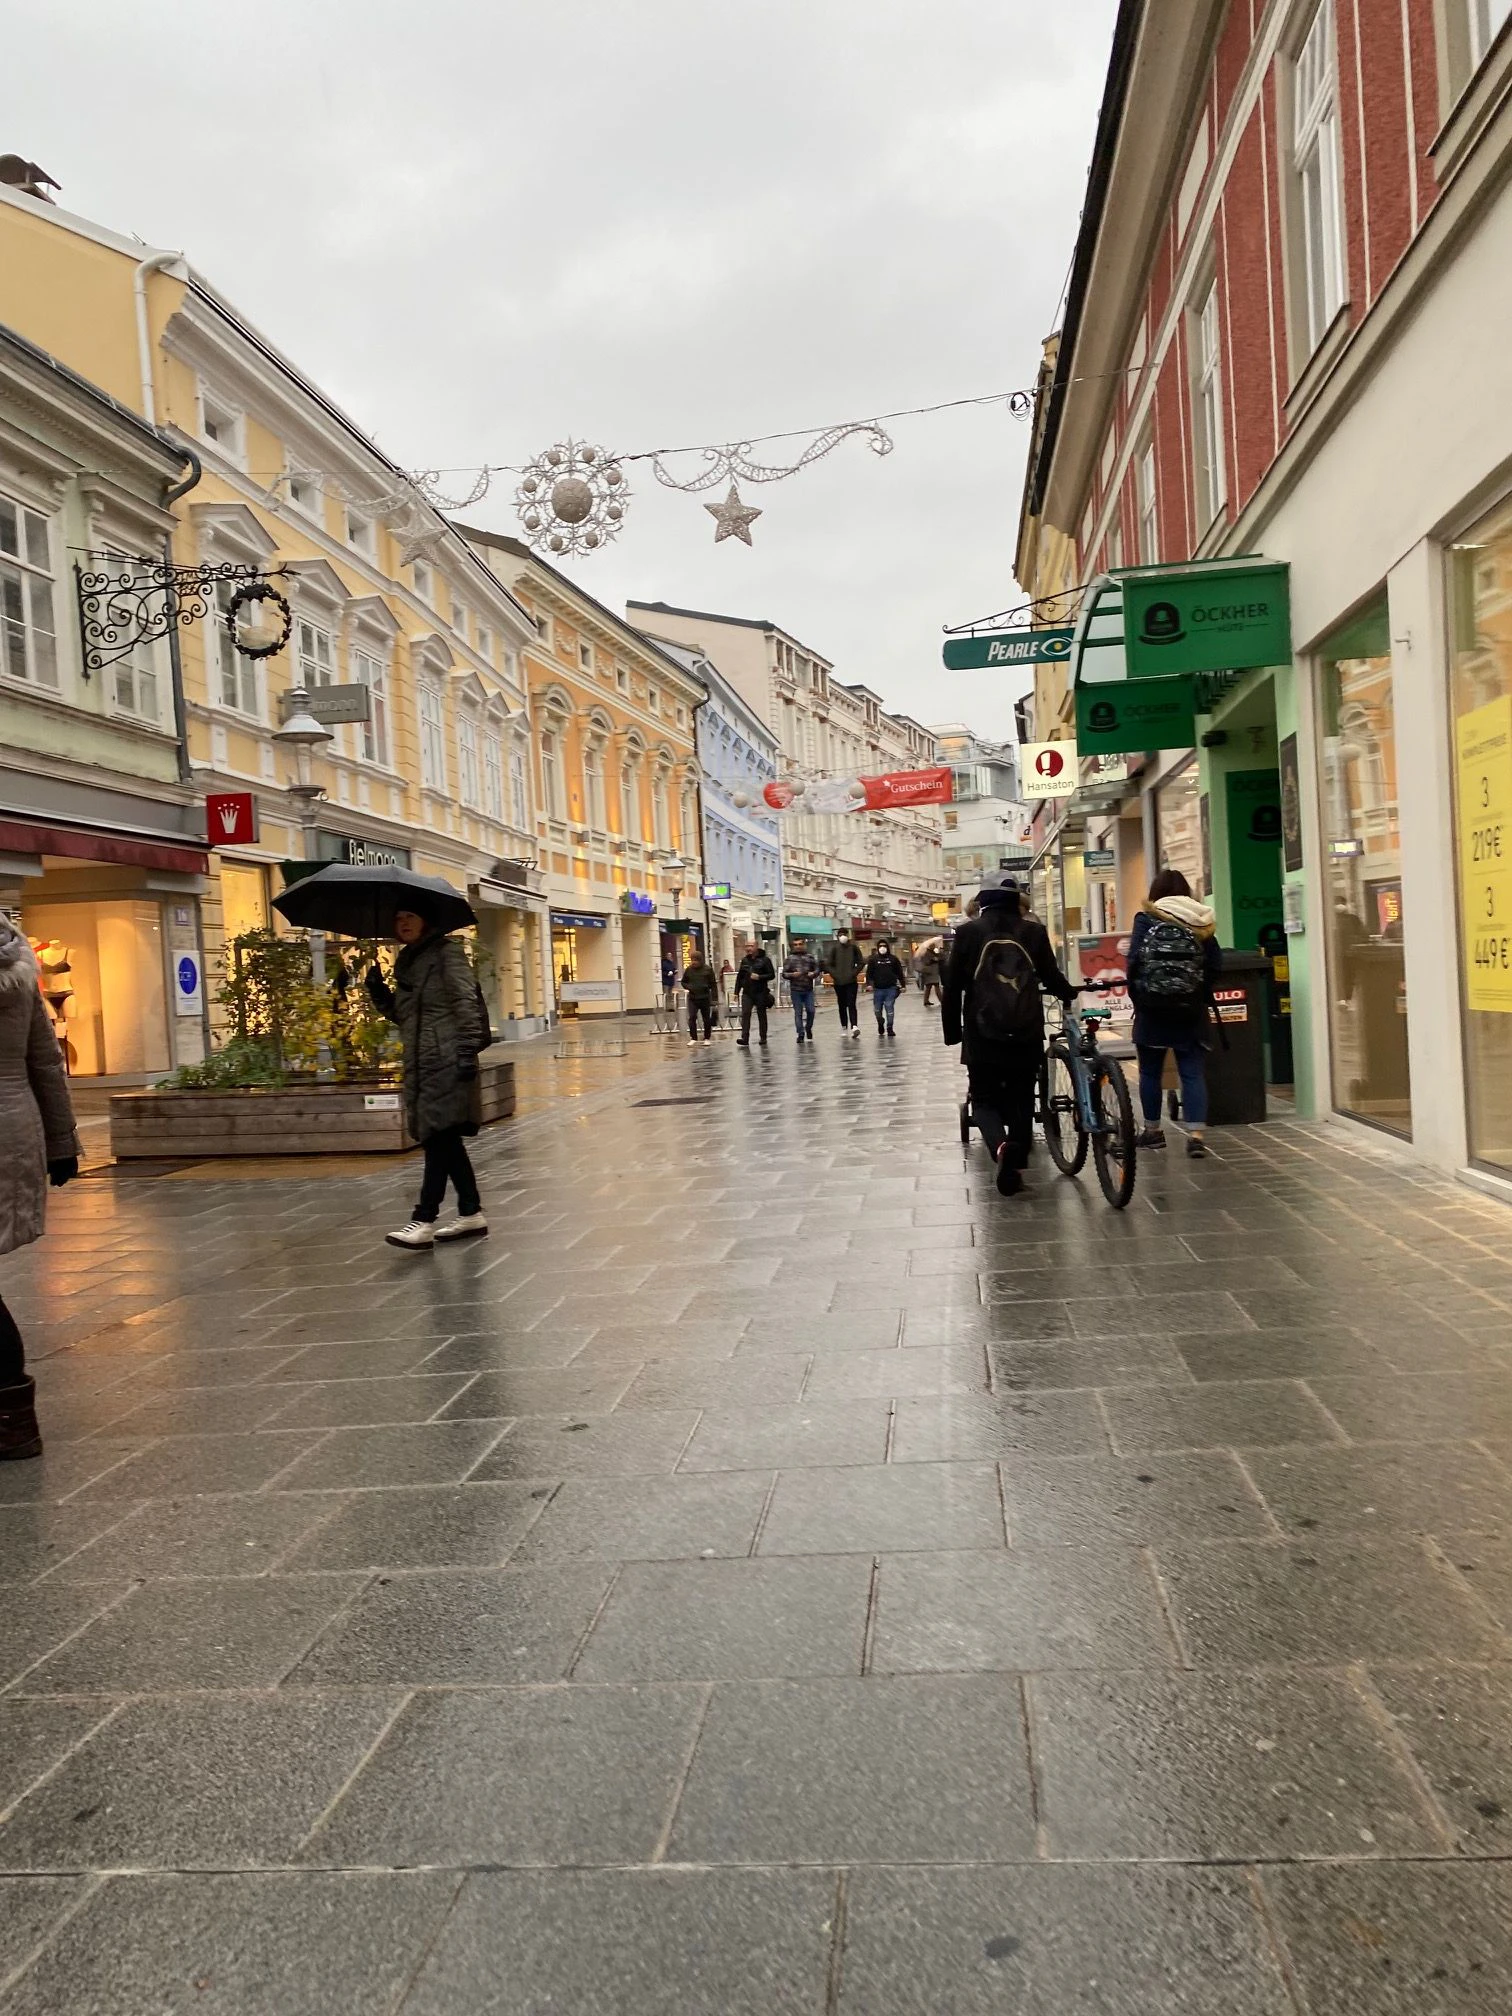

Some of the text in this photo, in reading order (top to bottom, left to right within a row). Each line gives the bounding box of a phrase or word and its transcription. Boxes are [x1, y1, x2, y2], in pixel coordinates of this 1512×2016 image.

[1192, 602, 1268, 622] ÖCKHER
[987, 641, 1039, 661] PEARLE
[890, 780, 944, 793] Gutschein
[1027, 780, 1075, 791] Hansaton
